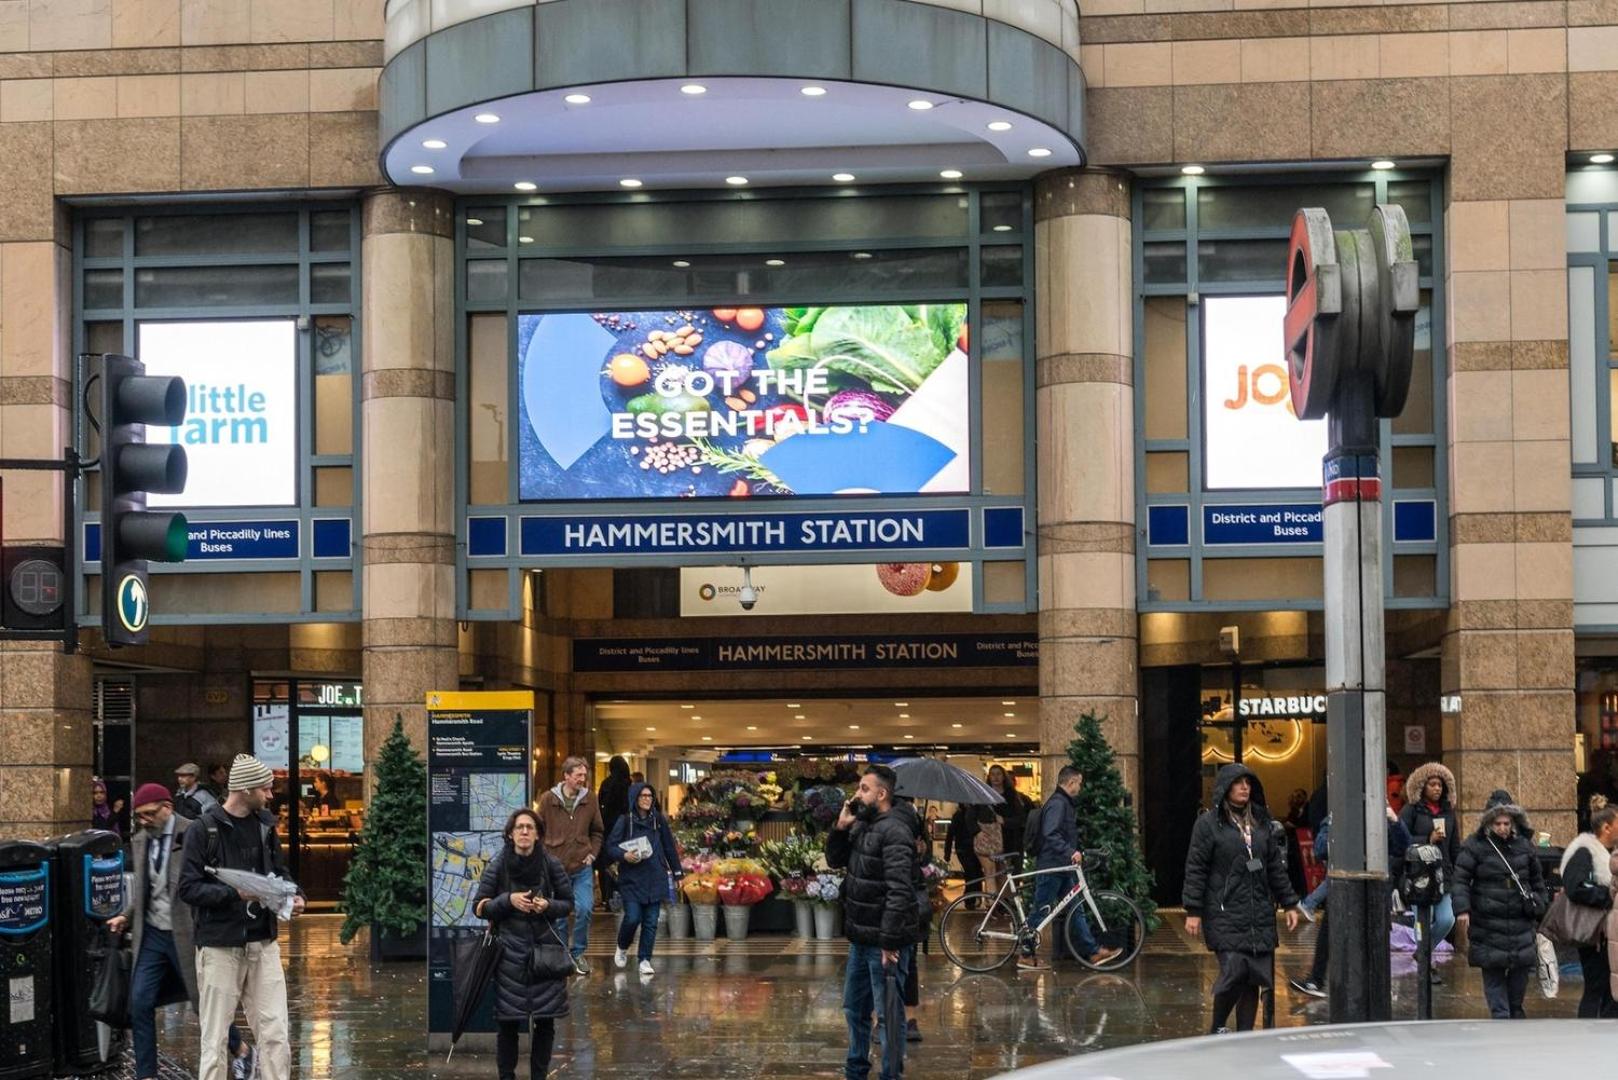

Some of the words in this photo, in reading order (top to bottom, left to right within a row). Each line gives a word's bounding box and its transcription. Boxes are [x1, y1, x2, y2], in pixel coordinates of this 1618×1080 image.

[654, 370, 739, 397] GOT
[752, 368, 829, 395] THE
[1224, 364, 1295, 416] JO
[190, 384, 266, 413] little
[612, 409, 874, 439] ESSENTIALS?
[1212, 512, 1256, 524] District
[1259, 512, 1281, 522] and
[187, 530, 207, 540] and
[210, 529, 261, 541] Piccadilly
[264, 528, 290, 538] lines
[564, 521, 785, 547] HAMMERSMITH
[800, 518, 924, 543] STATION
[1274, 525, 1309, 536] Buses
[200, 542, 233, 552] Buses
[718, 585, 767, 593] BROAAY
[599, 647, 627, 655] District
[629, 647, 643, 655] and
[644, 646, 679, 656] Piccadilly
[681, 646, 700, 654] lines
[638, 655, 660, 663] Buses
[718, 644, 866, 662] HAMMERSMITH
[875, 642, 958, 660] STATION
[318, 685, 343, 704] JOE
[1238, 695, 1328, 715] STARBUC
